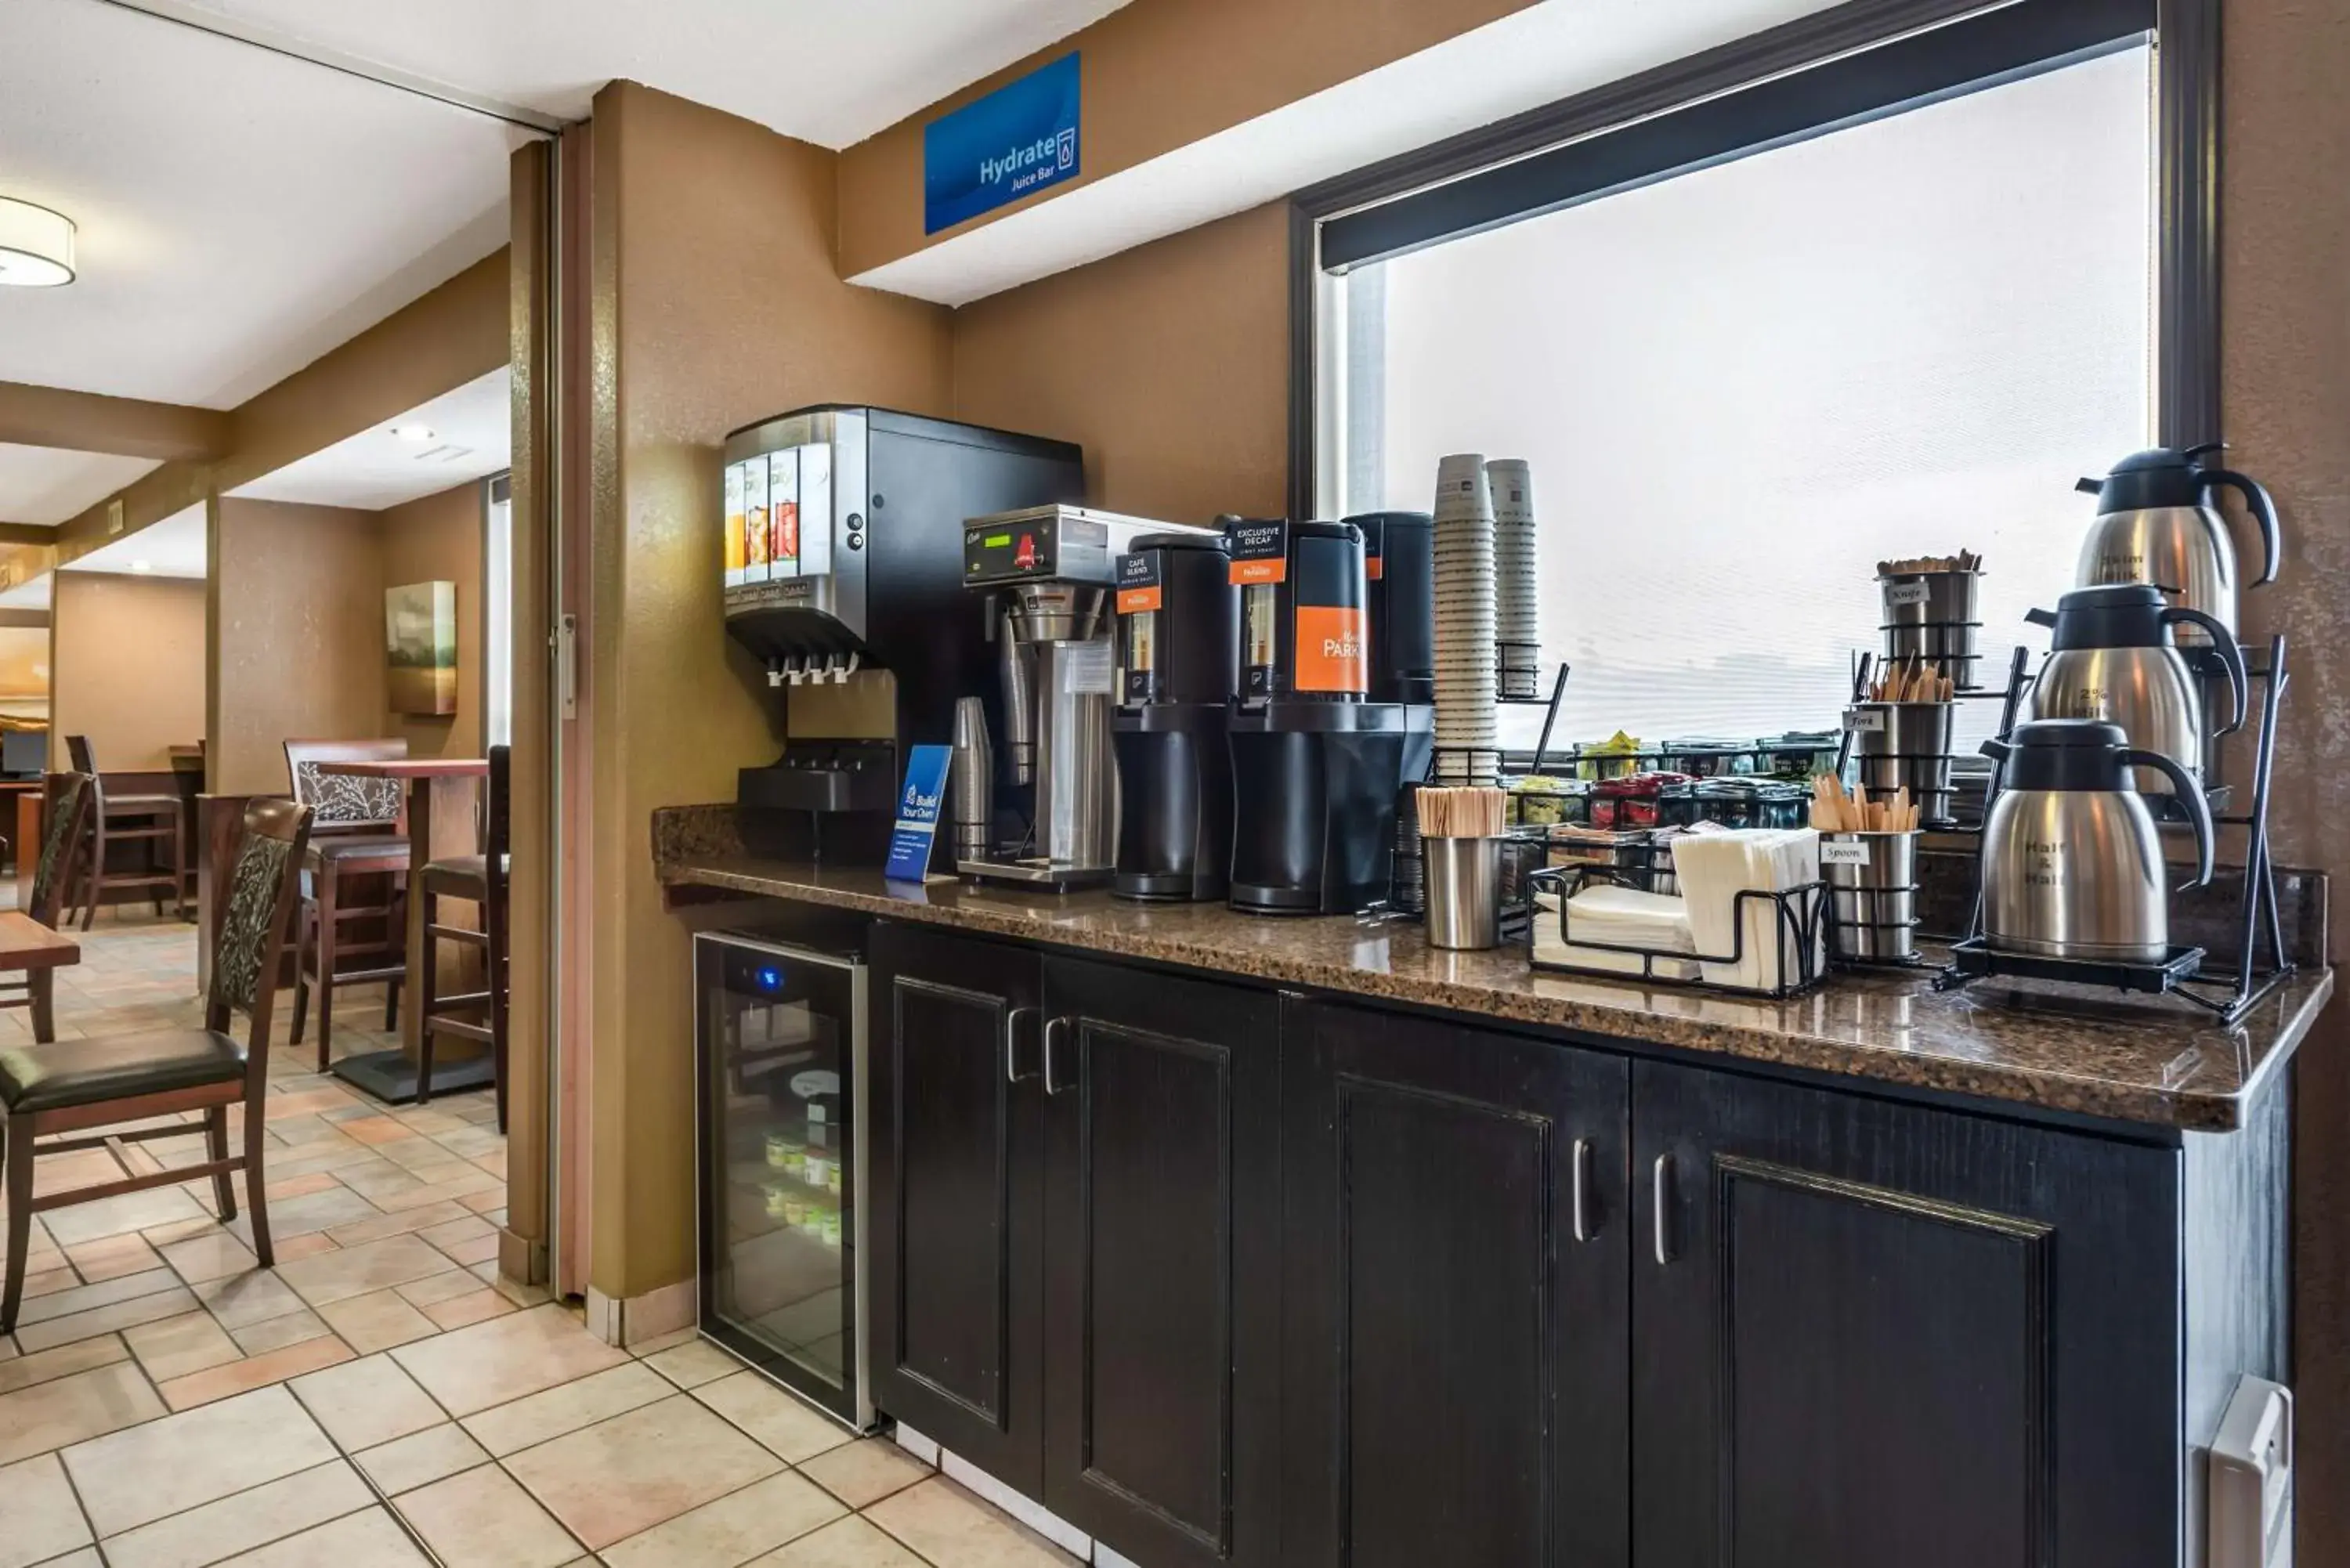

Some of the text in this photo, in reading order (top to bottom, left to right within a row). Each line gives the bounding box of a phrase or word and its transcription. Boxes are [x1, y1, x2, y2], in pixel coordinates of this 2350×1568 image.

[980, 136, 1055, 184] Hydrate
[1011, 165, 1055, 192] Juice Bar
[1237, 526, 1280, 538] EXCLUSIVE
[1245, 536, 1271, 546] DECAF
[2080, 688, 2110, 700] 2%
[916, 795, 938, 807] Build
[902, 806, 934, 818] Your Own
[1827, 847, 1860, 859] Spoon
